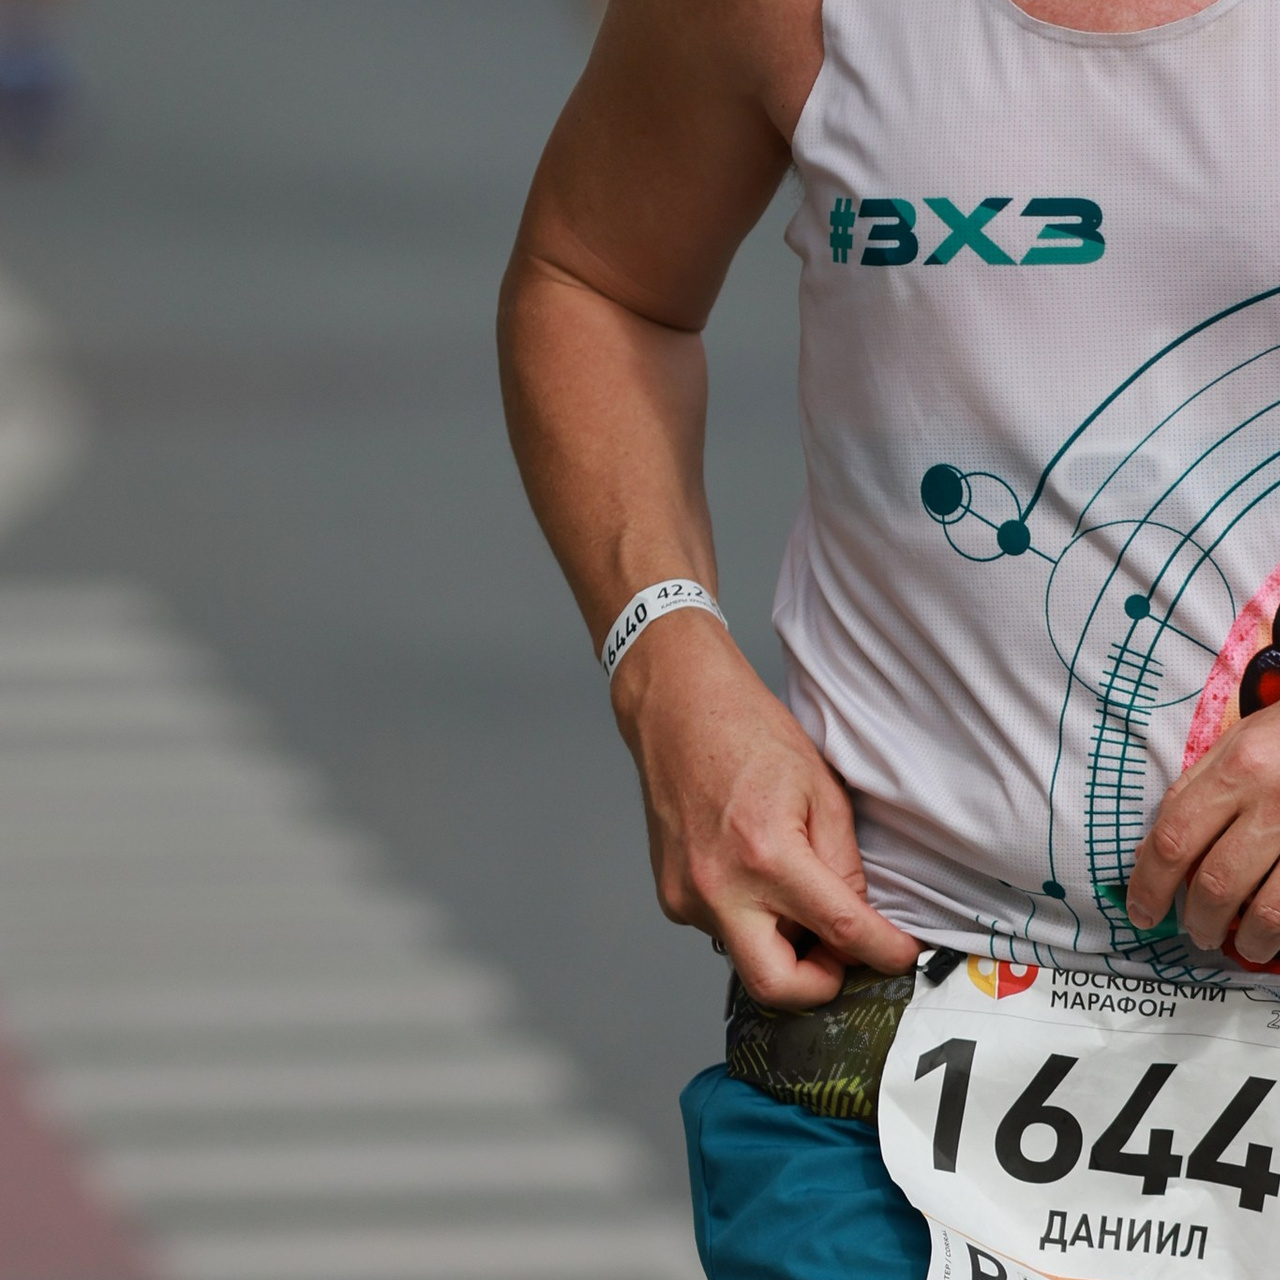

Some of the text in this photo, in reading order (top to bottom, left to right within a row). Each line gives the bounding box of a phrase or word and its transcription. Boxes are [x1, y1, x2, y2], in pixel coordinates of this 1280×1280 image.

[603, 603, 648, 677] 16440
[1050, 990, 1177, 1018] МАРАФОН
[1038, 1209, 1210, 1261] ДАНИИЛ
